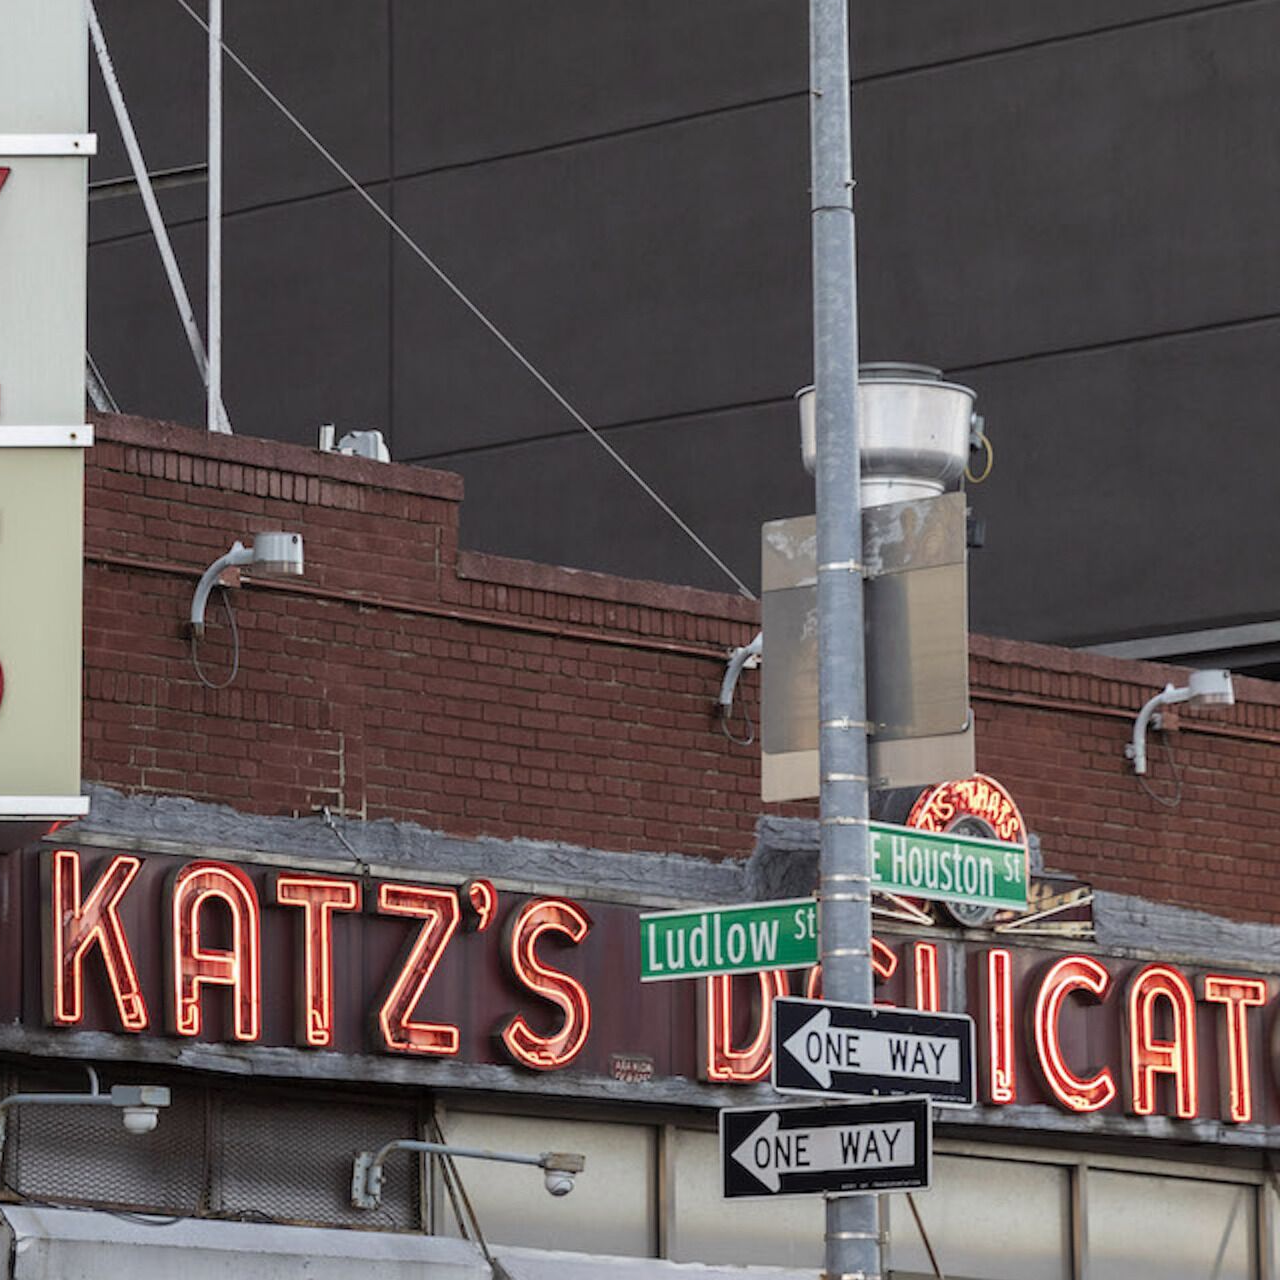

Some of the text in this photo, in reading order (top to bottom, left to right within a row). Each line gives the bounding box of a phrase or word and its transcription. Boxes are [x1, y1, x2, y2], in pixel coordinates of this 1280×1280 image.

[891, 836, 995, 897] Houston
[1003, 850, 1021, 884] St
[53, 849, 593, 1071] KATZ'S
[648, 907, 817, 972] Ludlow St
[806, 1031, 948, 1075] ONE WAY
[754, 1127, 901, 1169] ONE WAY
